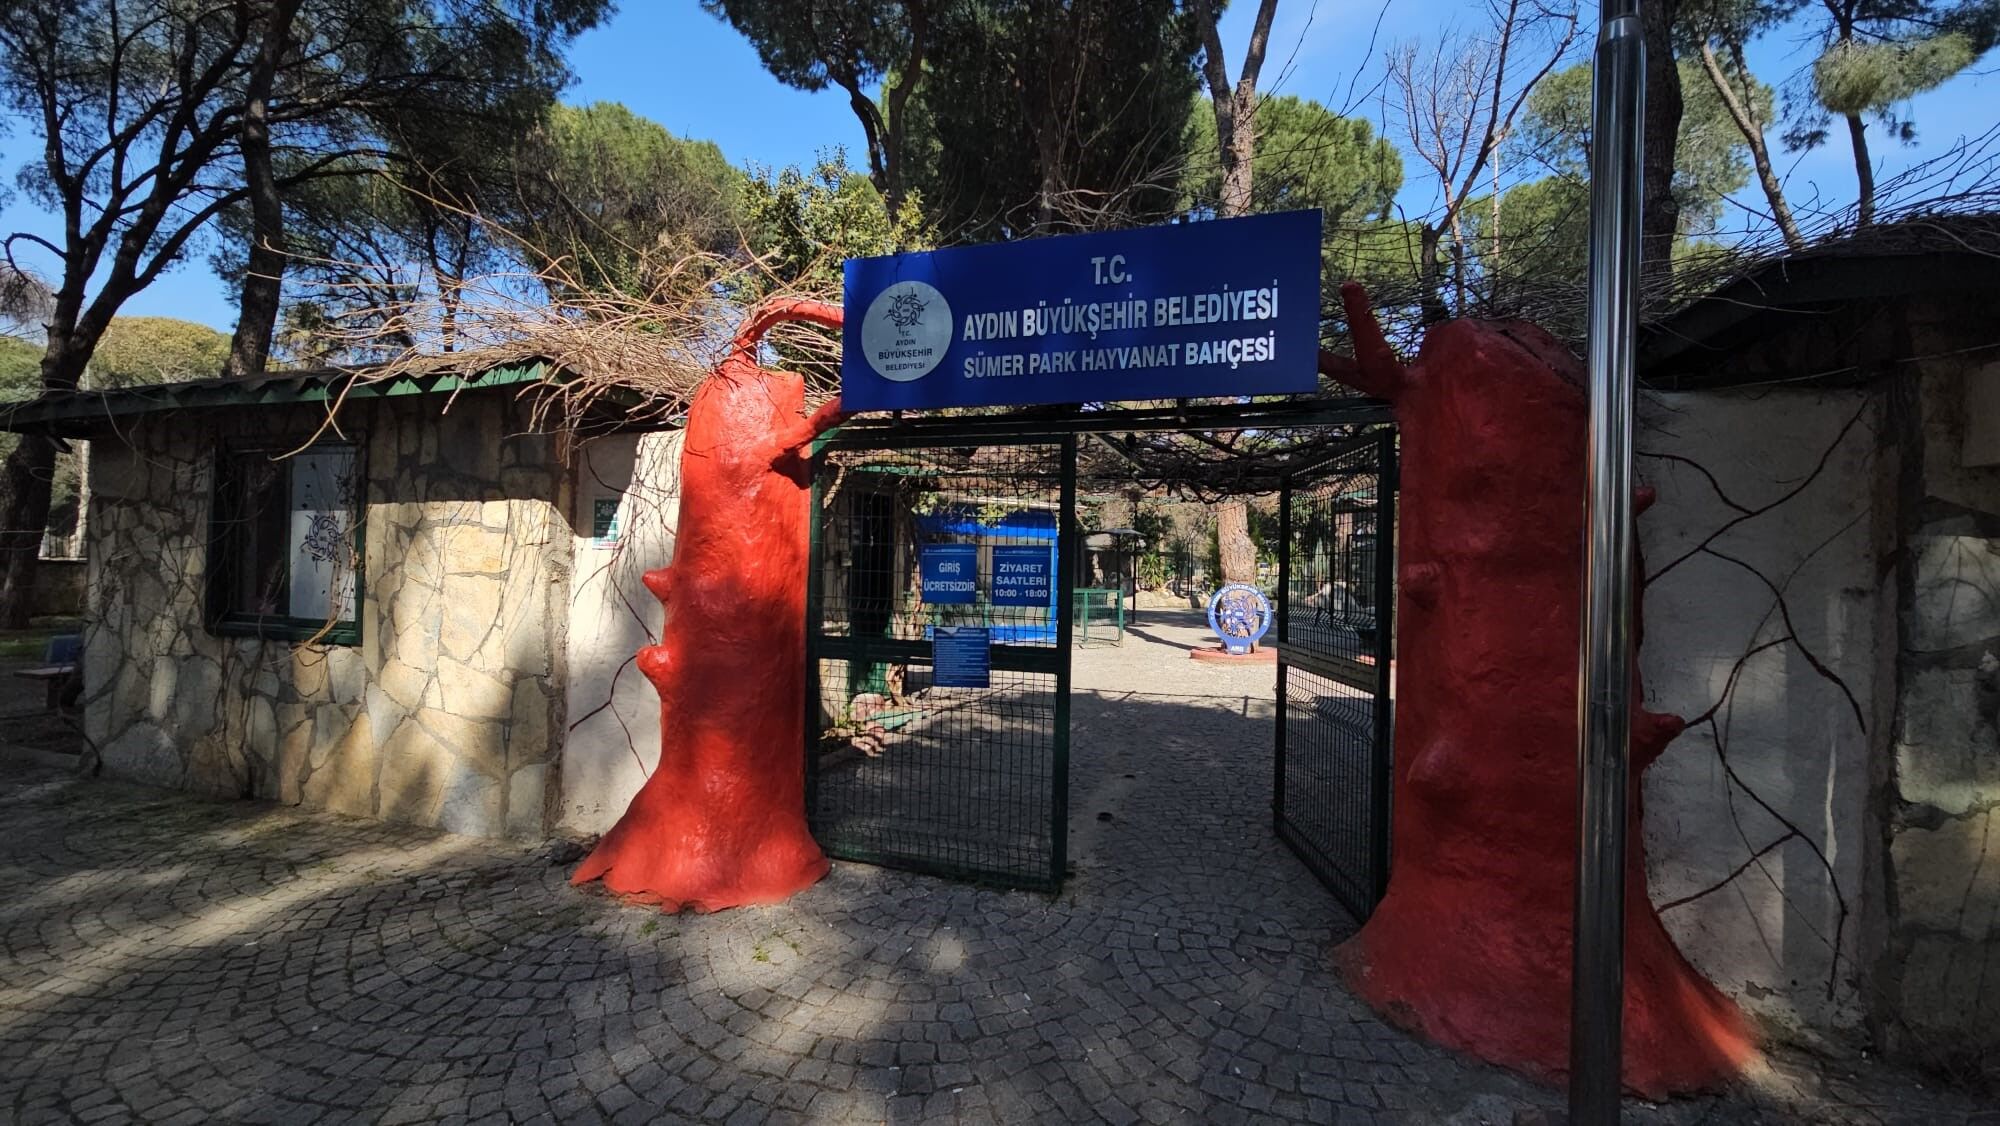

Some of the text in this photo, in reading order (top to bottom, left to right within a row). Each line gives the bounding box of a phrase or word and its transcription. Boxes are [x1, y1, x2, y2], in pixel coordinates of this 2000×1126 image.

[1091, 254, 1132, 285] T.C.
[963, 279, 1278, 341] AYDIN BÜYÜKŞEHİR BELEDİYESİ
[878, 346, 933, 360] BÜYÜKŞEHİR
[964, 330, 1275, 378] SÜMER PARK HAYVANAT BAHÇESİ
[938, 562, 961, 575] GİRİŞ
[999, 562, 1043, 573] ZİYARET
[924, 579, 976, 592] ÜCRETSİZDİR
[996, 575, 1047, 586] SAATLERİ
[994, 589, 1017, 597] 10:00
[1025, 589, 1048, 598] 18:00
